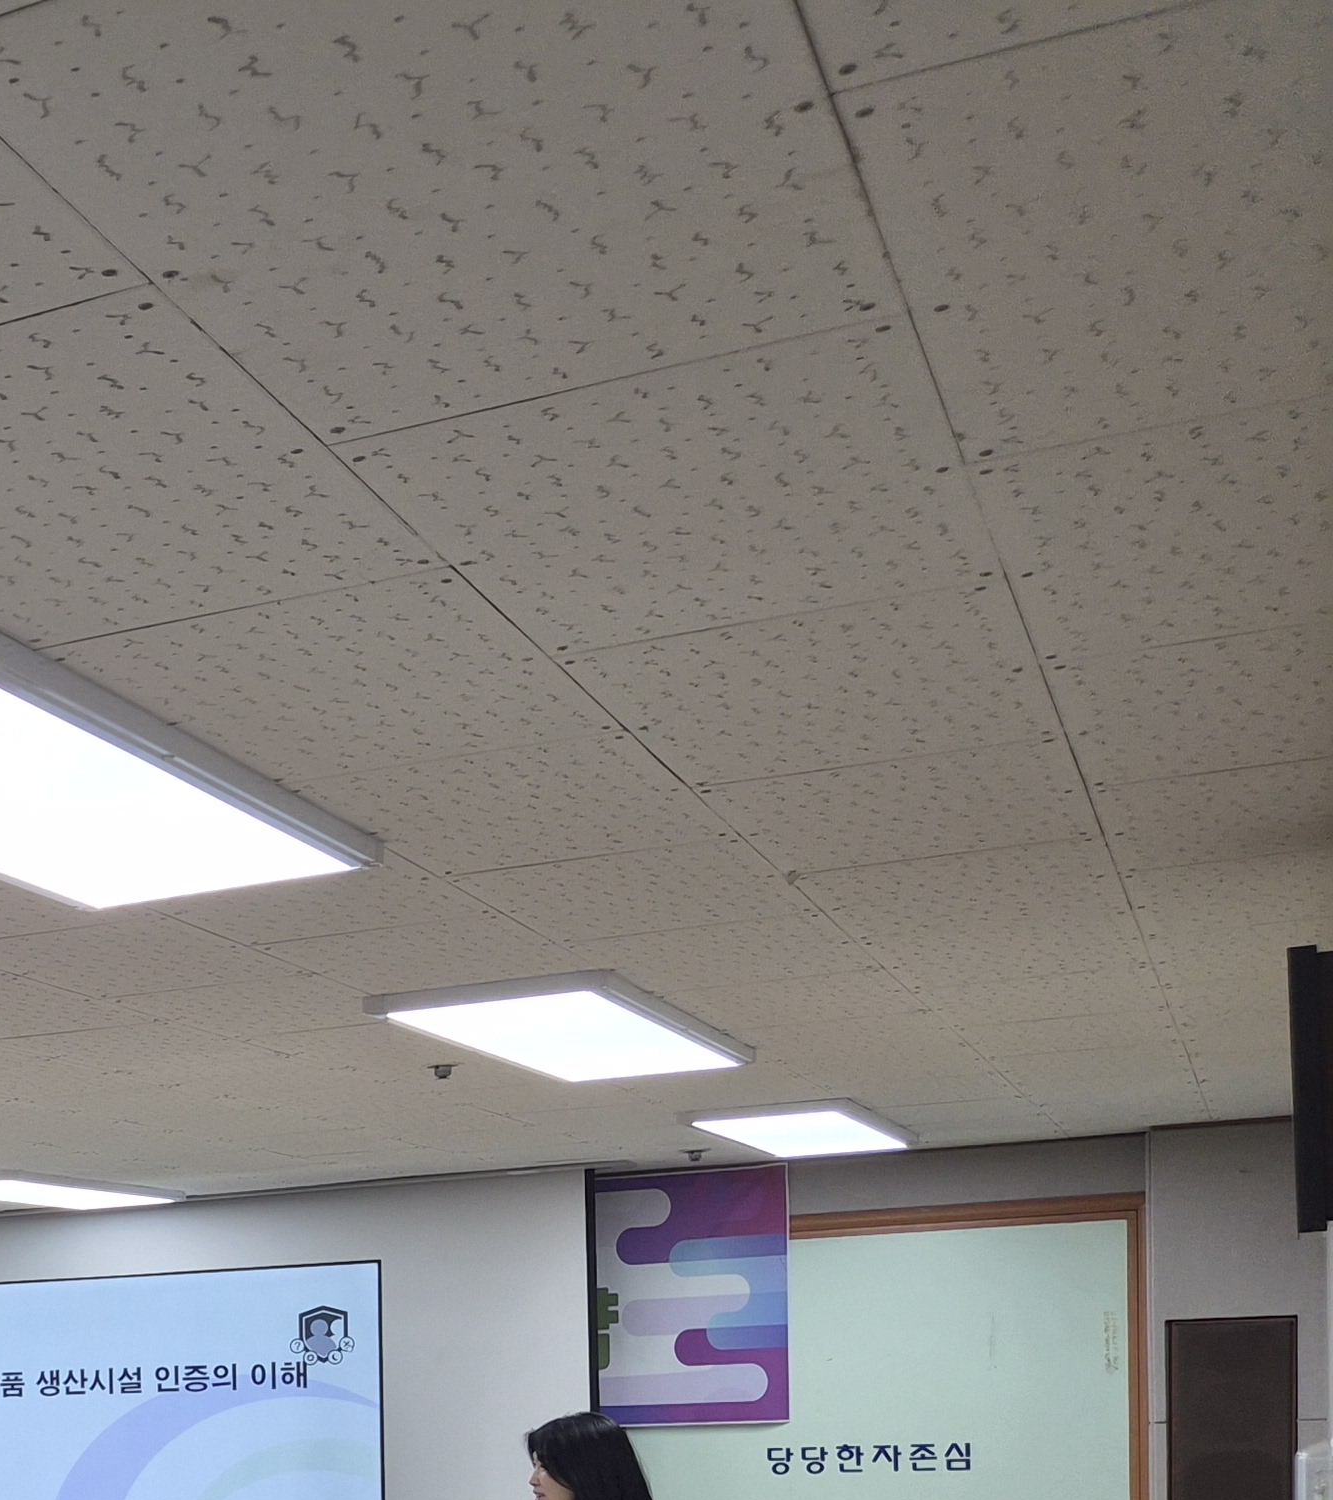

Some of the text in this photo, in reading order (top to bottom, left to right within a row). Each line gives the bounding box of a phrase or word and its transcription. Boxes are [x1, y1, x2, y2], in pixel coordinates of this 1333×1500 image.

[36, 1367, 142, 1397] 생산시설
[155, 1363, 237, 1392] 인증의
[251, 1361, 308, 1389] 이해
[766, 1442, 971, 1475] 당당한자존심
